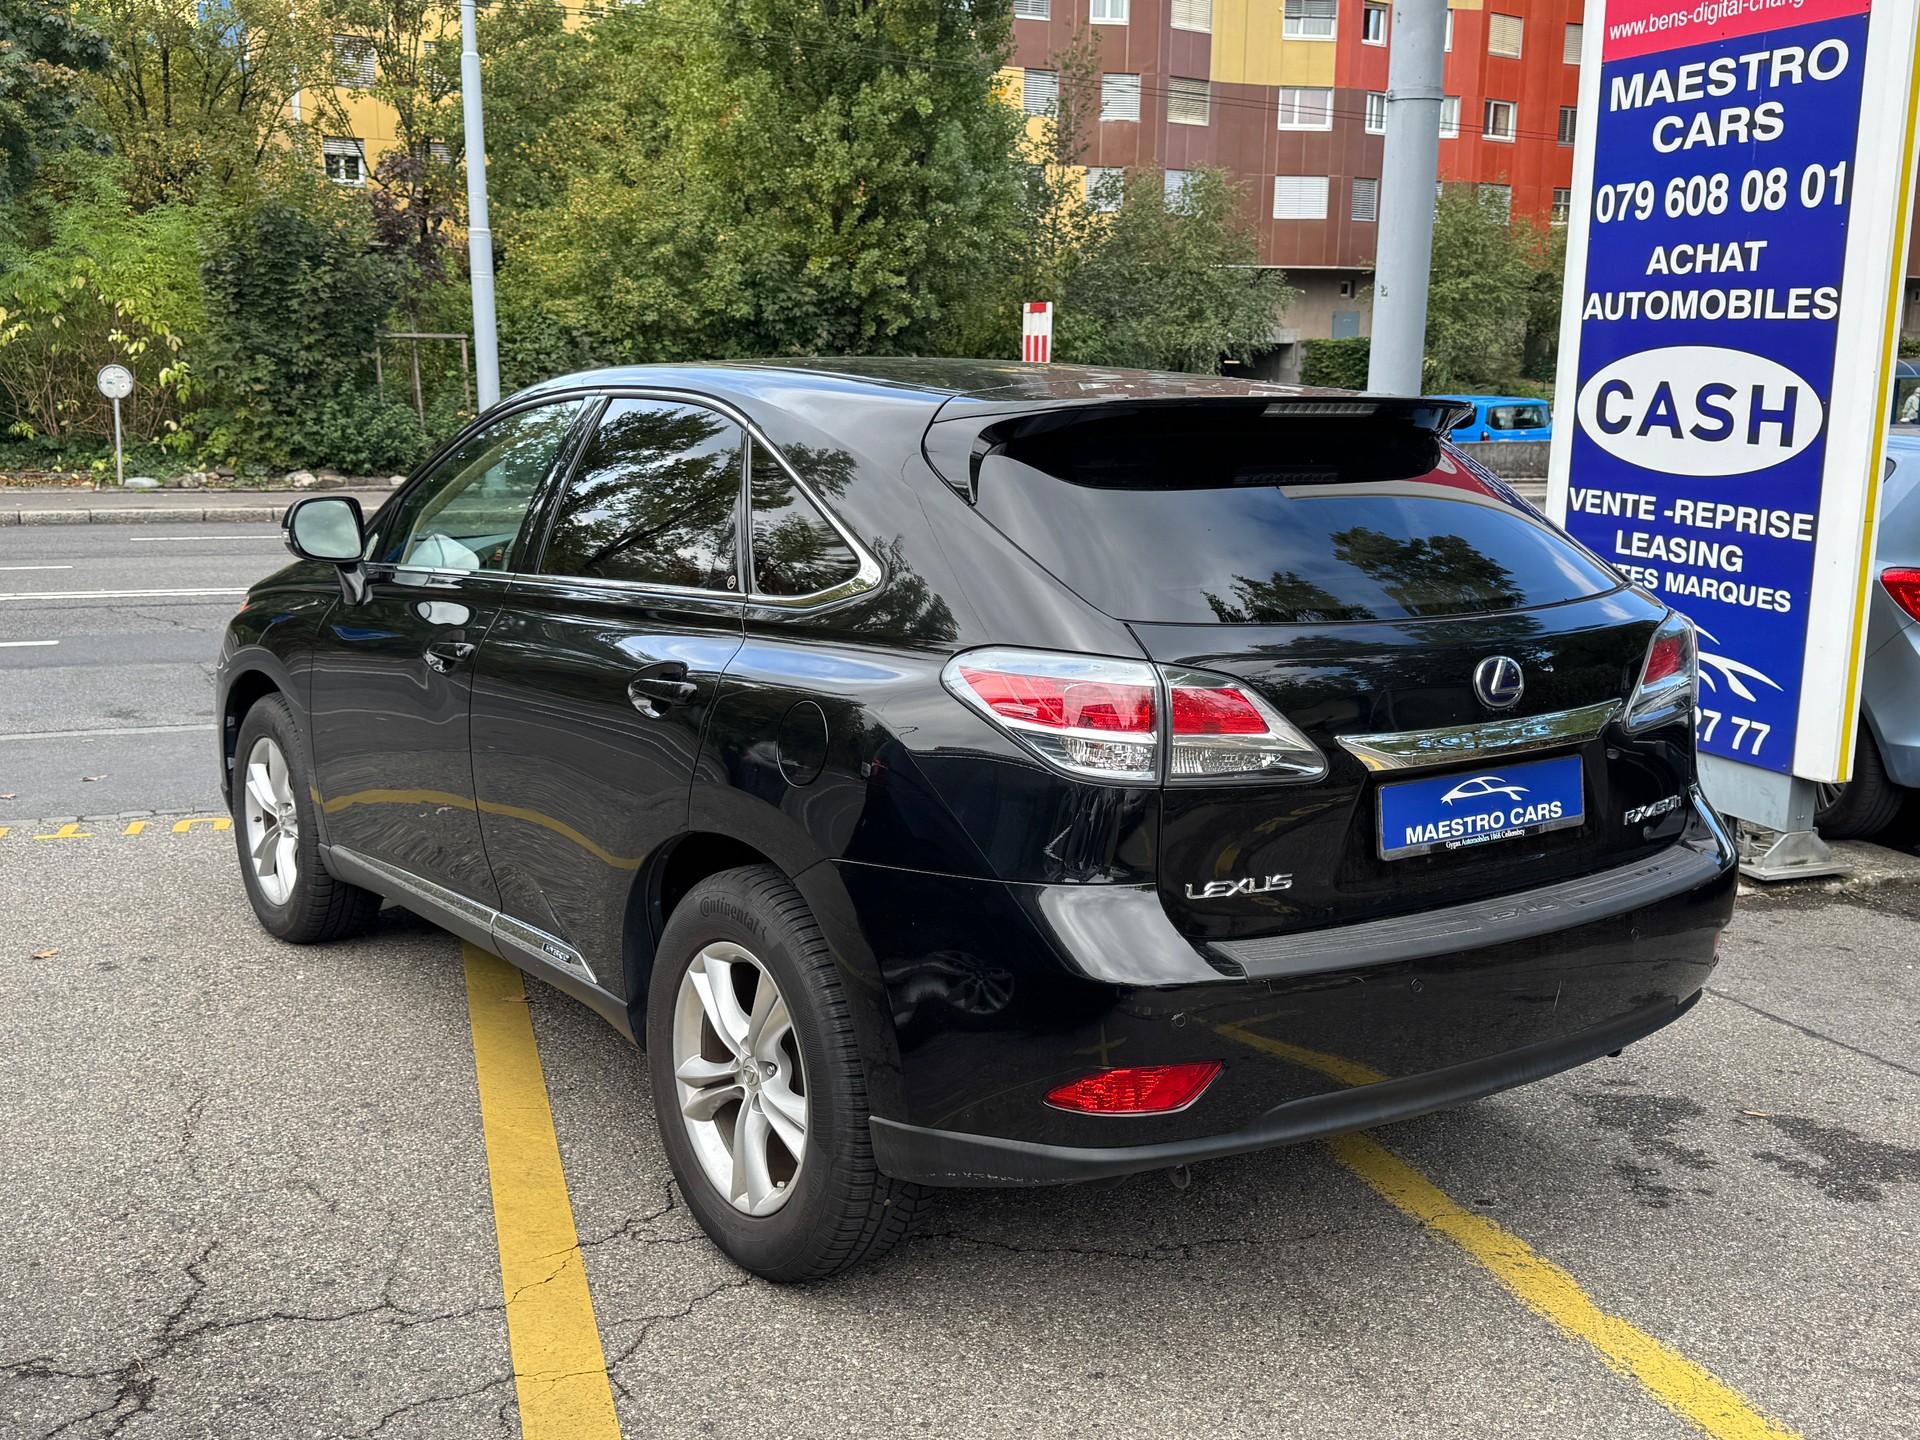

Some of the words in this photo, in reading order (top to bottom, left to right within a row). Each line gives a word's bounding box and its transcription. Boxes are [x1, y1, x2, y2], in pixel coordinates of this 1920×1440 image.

[1609, 38, 1849, 112] MAESTRO
[1651, 101, 1785, 153] CARS
[1596, 180, 1655, 223] 079
[1664, 173, 1729, 218] 608
[1740, 167, 1788, 212] 08
[1800, 161, 1847, 208] 01
[1645, 241, 1768, 275] ACHAT
[1582, 286, 1838, 320] AUTOMOBILES
[1596, 379, 1799, 448] CASH
[1569, 487, 1656, 521] VENTE
[1663, 499, 1814, 542] -REPRISE
[1615, 529, 1744, 573] LEASING
[1613, 563, 1659, 590] TES
[1665, 572, 1792, 613] MARQUES
[1731, 715, 1771, 756] 77
[1405, 811, 1505, 845] MAESTRO
[1510, 801, 1562, 825] CARS
[1185, 873, 1293, 900] LEXUS
[700, 896, 760, 936] Continental
